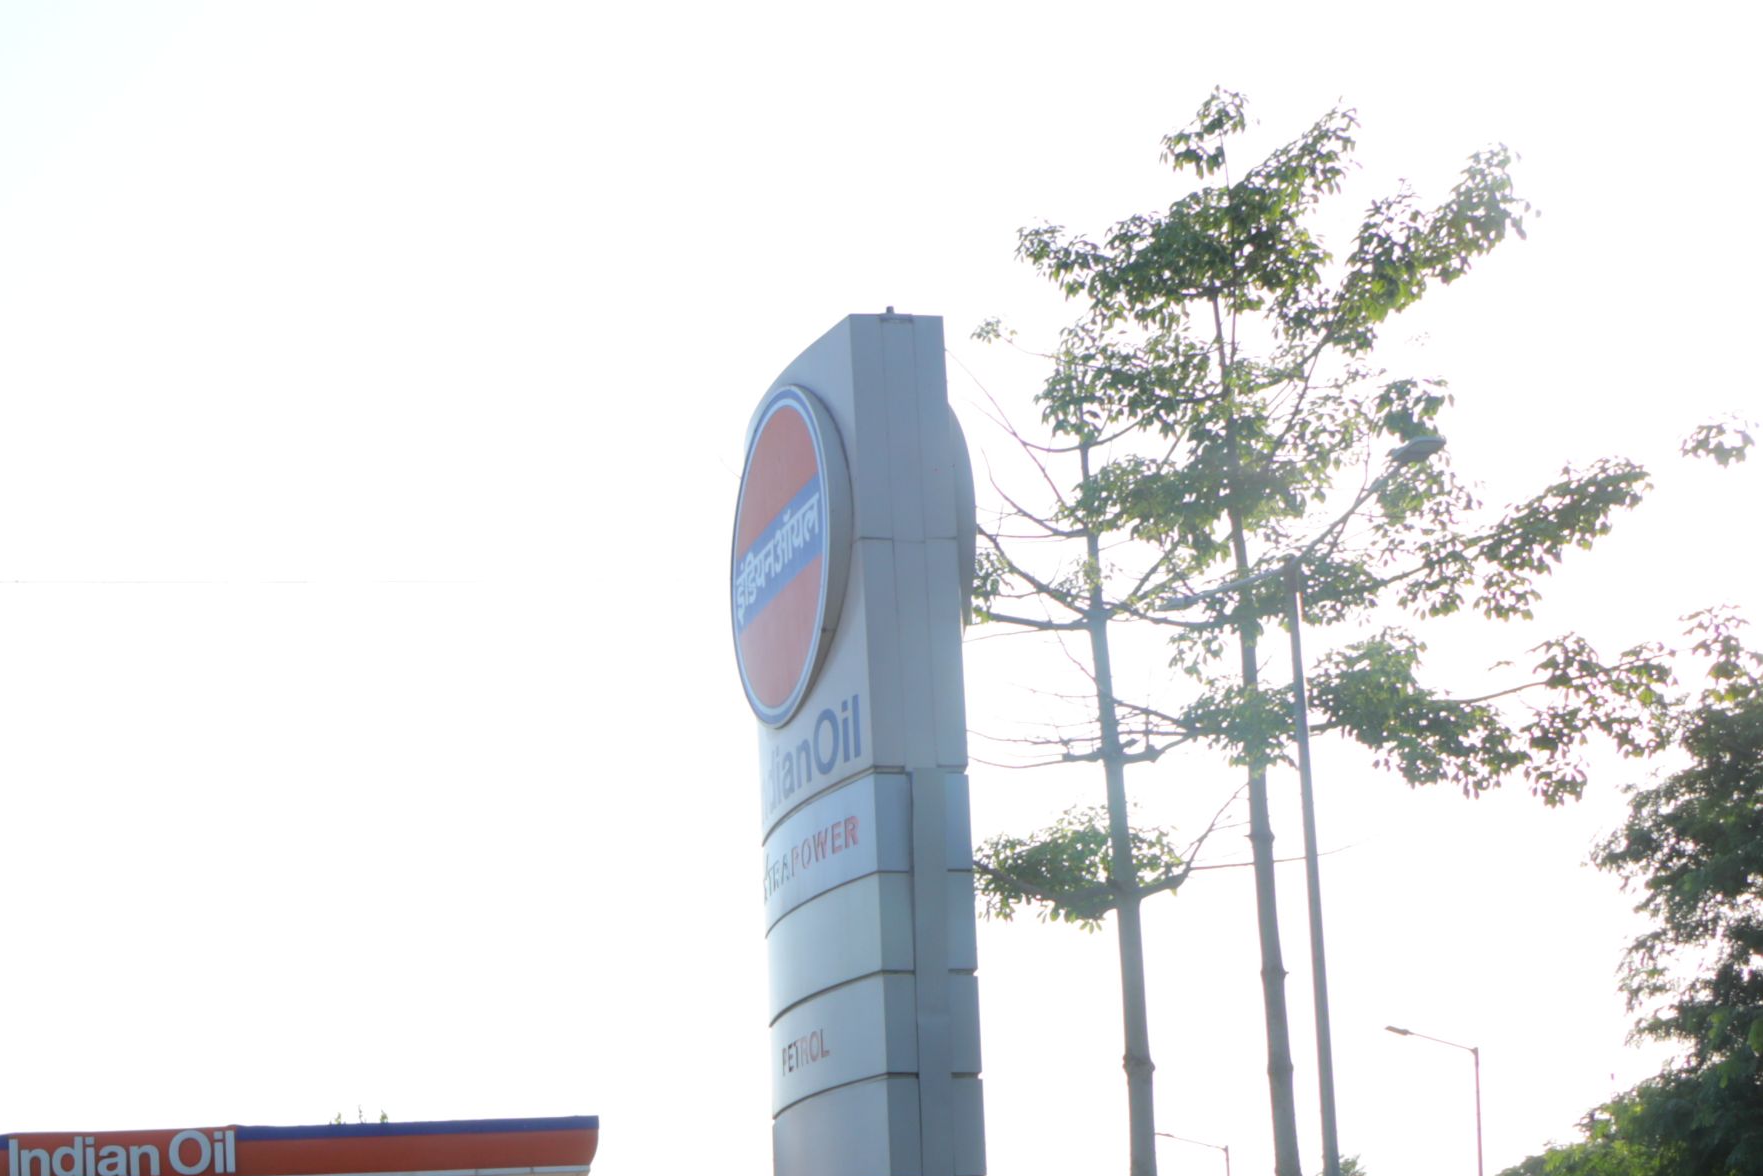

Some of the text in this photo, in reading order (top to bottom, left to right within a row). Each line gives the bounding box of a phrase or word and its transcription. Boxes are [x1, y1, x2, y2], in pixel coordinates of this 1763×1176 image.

[737, 492, 820, 625] इंडियनऑयल
[782, 1028, 831, 1076] PETROL
[168, 1129, 236, 1176] Oil
